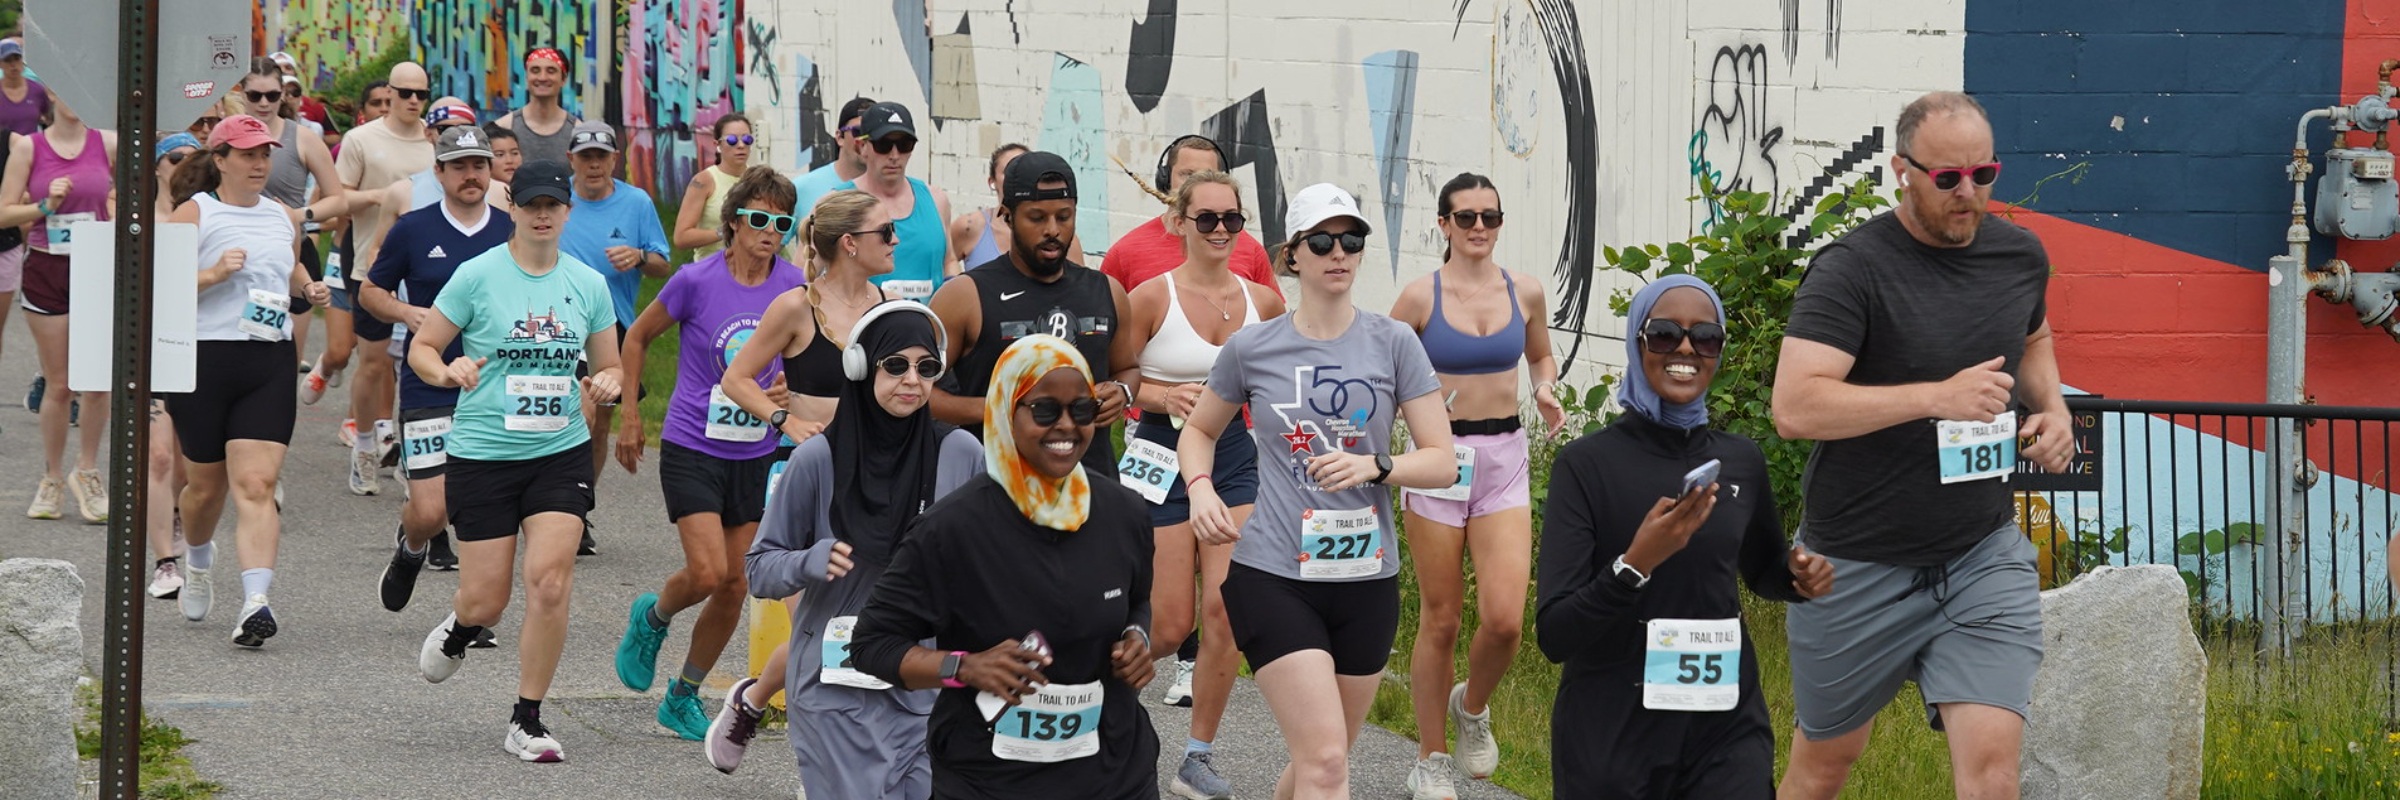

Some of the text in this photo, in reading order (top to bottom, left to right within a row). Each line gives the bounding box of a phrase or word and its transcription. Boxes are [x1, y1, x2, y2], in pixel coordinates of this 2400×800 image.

[251, 305, 286, 329] 320
[720, 320, 742, 339] BEACH
[741, 318, 752, 326] TO
[532, 382, 565, 391] TRAIL TO ALE
[516, 396, 562, 416] 256
[717, 406, 762, 427] 209
[1971, 426, 1989, 437] TRAIL
[1991, 424, 1999, 434] TO
[2000, 422, 2009, 433] ALE
[412, 435, 445, 456] 319
[1142, 447, 1174, 465] TRAIL TO ALE
[1961, 443, 2003, 473] 181
[1120, 457, 1165, 486] 236
[1335, 519, 1354, 529] TRAIL
[1356, 518, 1364, 527] TO
[1365, 515, 1373, 525] ALE
[1316, 533, 1372, 560] 227
[1690, 631, 1712, 643] TRAIL
[1715, 631, 1724, 643] TO
[1725, 630, 1734, 642] ALE
[1676, 653, 1723, 685] 55
[1038, 693, 1093, 706] TRAIL TO ALE
[1016, 710, 1082, 741] 139
